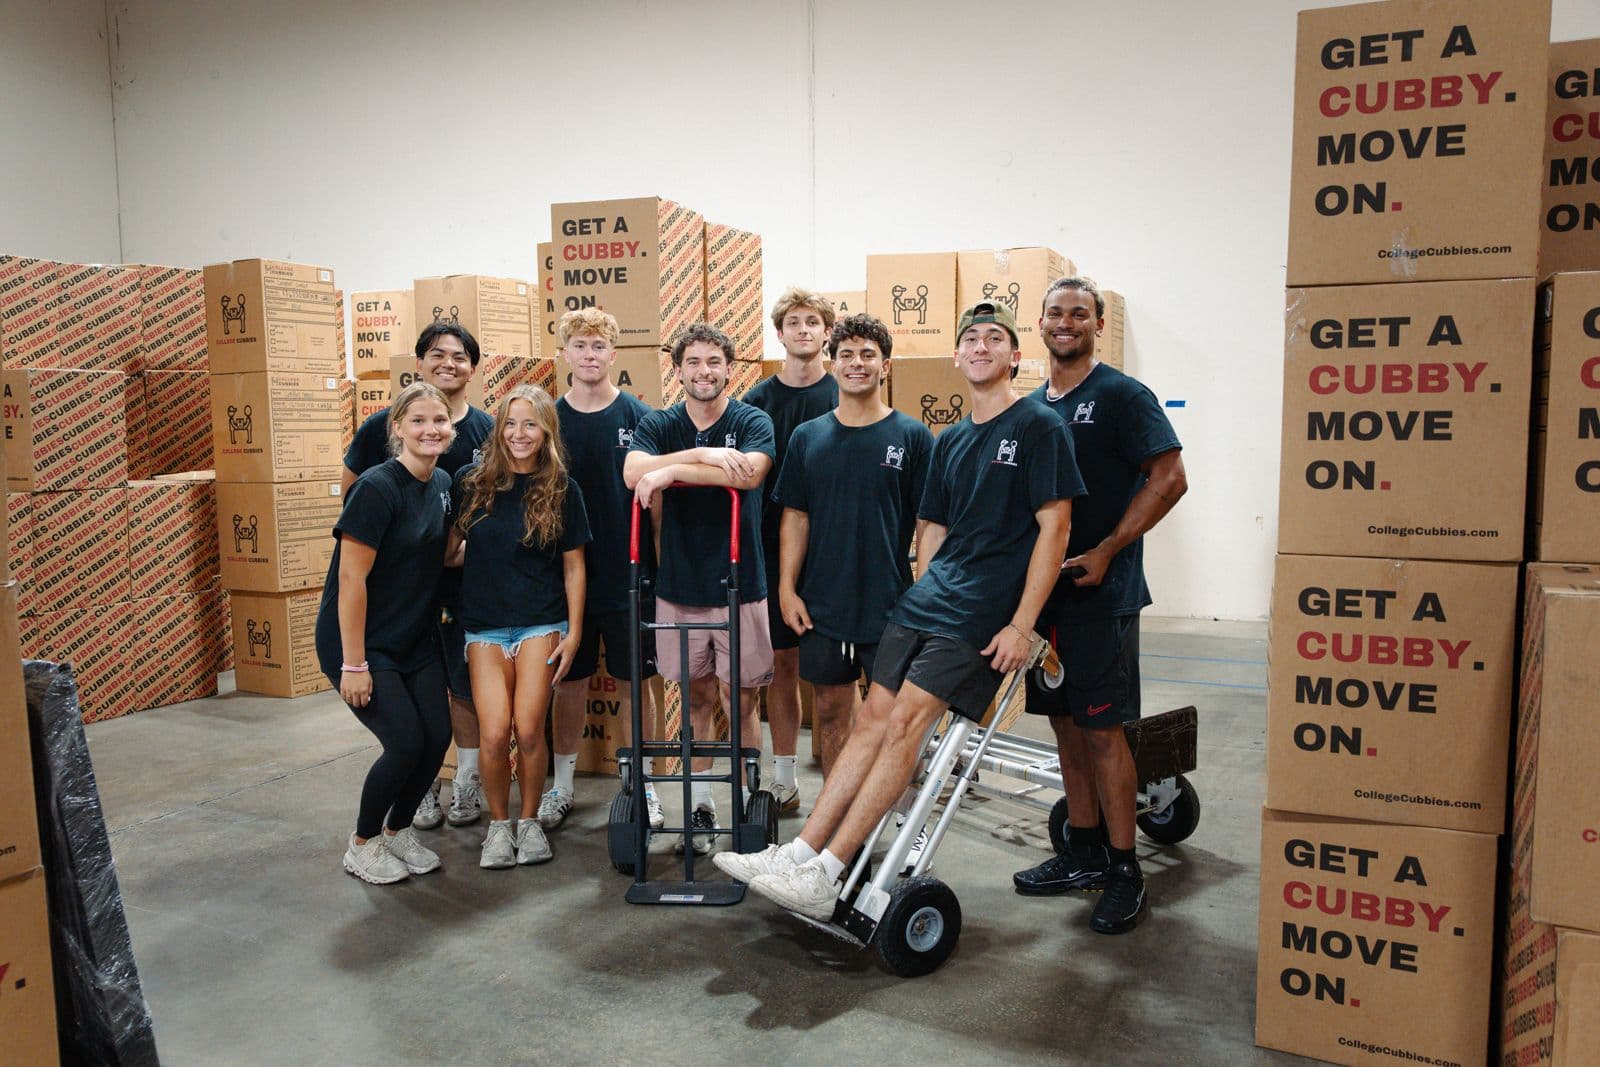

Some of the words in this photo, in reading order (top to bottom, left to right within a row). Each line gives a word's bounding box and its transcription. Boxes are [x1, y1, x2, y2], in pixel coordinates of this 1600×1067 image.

[1321, 30, 1424, 70] GET
[1441, 25, 1477, 58] A
[1319, 72, 1516, 118] CUBBY.
[1317, 124, 1466, 166] MOVE
[1315, 182, 1402, 216] ON.
[562, 218, 606, 236] GET
[613, 216, 628, 233] A
[563, 241, 647, 261] CUBBY.
[1378, 245, 1512, 259] CollegeCubbies.com
[564, 267, 627, 286] MOVE
[357, 302, 379, 312] GET
[384, 301, 391, 311] A
[357, 316, 400, 328] CUBBY.
[839, 301, 849, 311] A
[357, 332, 390, 342] MOVE
[1310, 317, 1410, 349] GET
[1427, 315, 1462, 346] A
[358, 348, 377, 358] ON.
[35, 371, 80, 399] CUBBIES
[45, 379, 88, 408] CUBBIES
[618, 370, 632, 386] A
[1309, 362, 1501, 395] CUBBY.
[49, 391, 92, 420] CUBBIES
[362, 391, 384, 400] GET
[58, 400, 101, 429] CUBBIES
[62, 412, 105, 441] CUBBIES
[1307, 411, 1452, 440] MOVE
[34, 445, 73, 472] UBBIES
[71, 421, 113, 451] CUBBIES
[35, 458, 77, 488] UBBIES
[75, 432, 117, 462] CUBBIES
[45, 466, 85, 492] UBBIES
[84, 441, 125, 471] CUBBIES
[87, 453, 127, 482] CUBBIES
[1305, 461, 1391, 490] ON.
[37, 489, 82, 522] CUBBIES
[47, 499, 92, 530] CUBBIES
[52, 510, 96, 541] CUBBIES
[61, 519, 105, 550] CUBBIES
[1368, 525, 1498, 538] CollegeCubbies.com
[65, 529, 108, 561] CUBBIES
[36, 565, 75, 594] UBBIES
[74, 538, 117, 570] CUBBIES
[36, 577, 80, 611] UBBIES
[78, 548, 120, 581] CUBBIES
[86, 557, 128, 588] CUBBIES
[90, 568, 130, 599] CUBBIES
[1298, 587, 1396, 619] GET
[1412, 592, 1446, 622] A
[43, 608, 87, 641] CUBBIES
[53, 615, 97, 649] CUBBIES
[57, 626, 100, 660] CUBBIES
[1297, 631, 1484, 670] CUBBY.
[72, 644, 112, 678] CUBBIES
[80, 652, 121, 686] CUBBIES
[83, 662, 124, 697] CUBBIES
[92, 669, 132, 704] CUBBIES
[1295, 675, 1437, 713] MOVE
[95, 680, 135, 715] CUBBIES
[1293, 723, 1377, 756] ON.
[1354, 789, 1481, 810] CollegeCubbies.com
[1284, 839, 1378, 877] GET
[1394, 856, 1427, 886] A
[1283, 881, 1464, 936] CUBBY.
[1282, 922, 1418, 973] MOVE
[1280, 968, 1360, 1007] ON.
